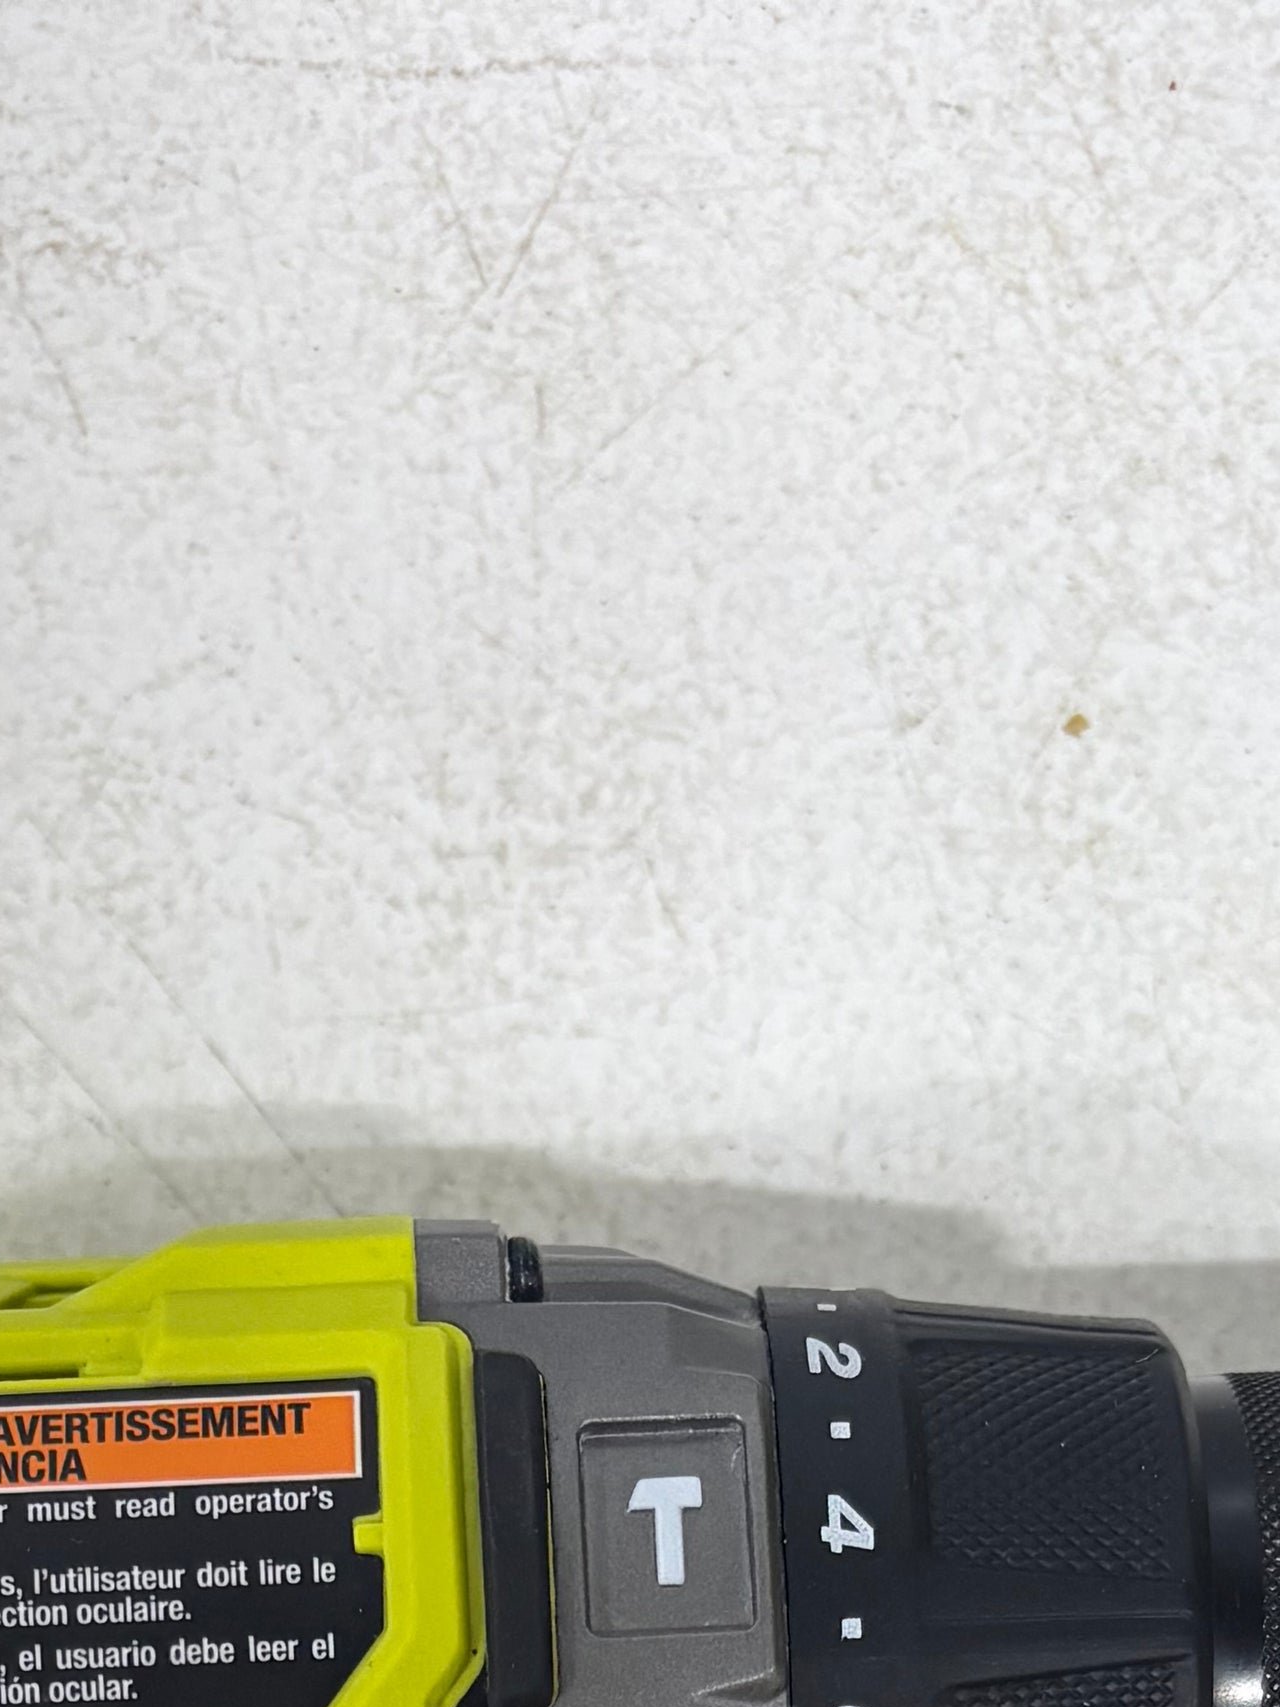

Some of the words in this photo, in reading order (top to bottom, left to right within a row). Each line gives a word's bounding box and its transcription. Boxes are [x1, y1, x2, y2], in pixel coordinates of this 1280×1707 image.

[806, 1337, 863, 1380] 2
[27, 1495, 97, 1522] must
[115, 1491, 176, 1519] read
[821, 1494, 875, 1553] 4
[196, 1559, 249, 1588] doit
[258, 1558, 302, 1586] lire
[312, 1556, 336, 1583] le
[76, 1594, 192, 1625] oculaire.
[18, 1643, 42, 1672] el
[55, 1639, 157, 1670] usuario
[169, 1636, 235, 1666] debe
[247, 1635, 299, 1663] leer
[311, 1632, 335, 1660] el
[48, 1673, 138, 1703] ocular.
